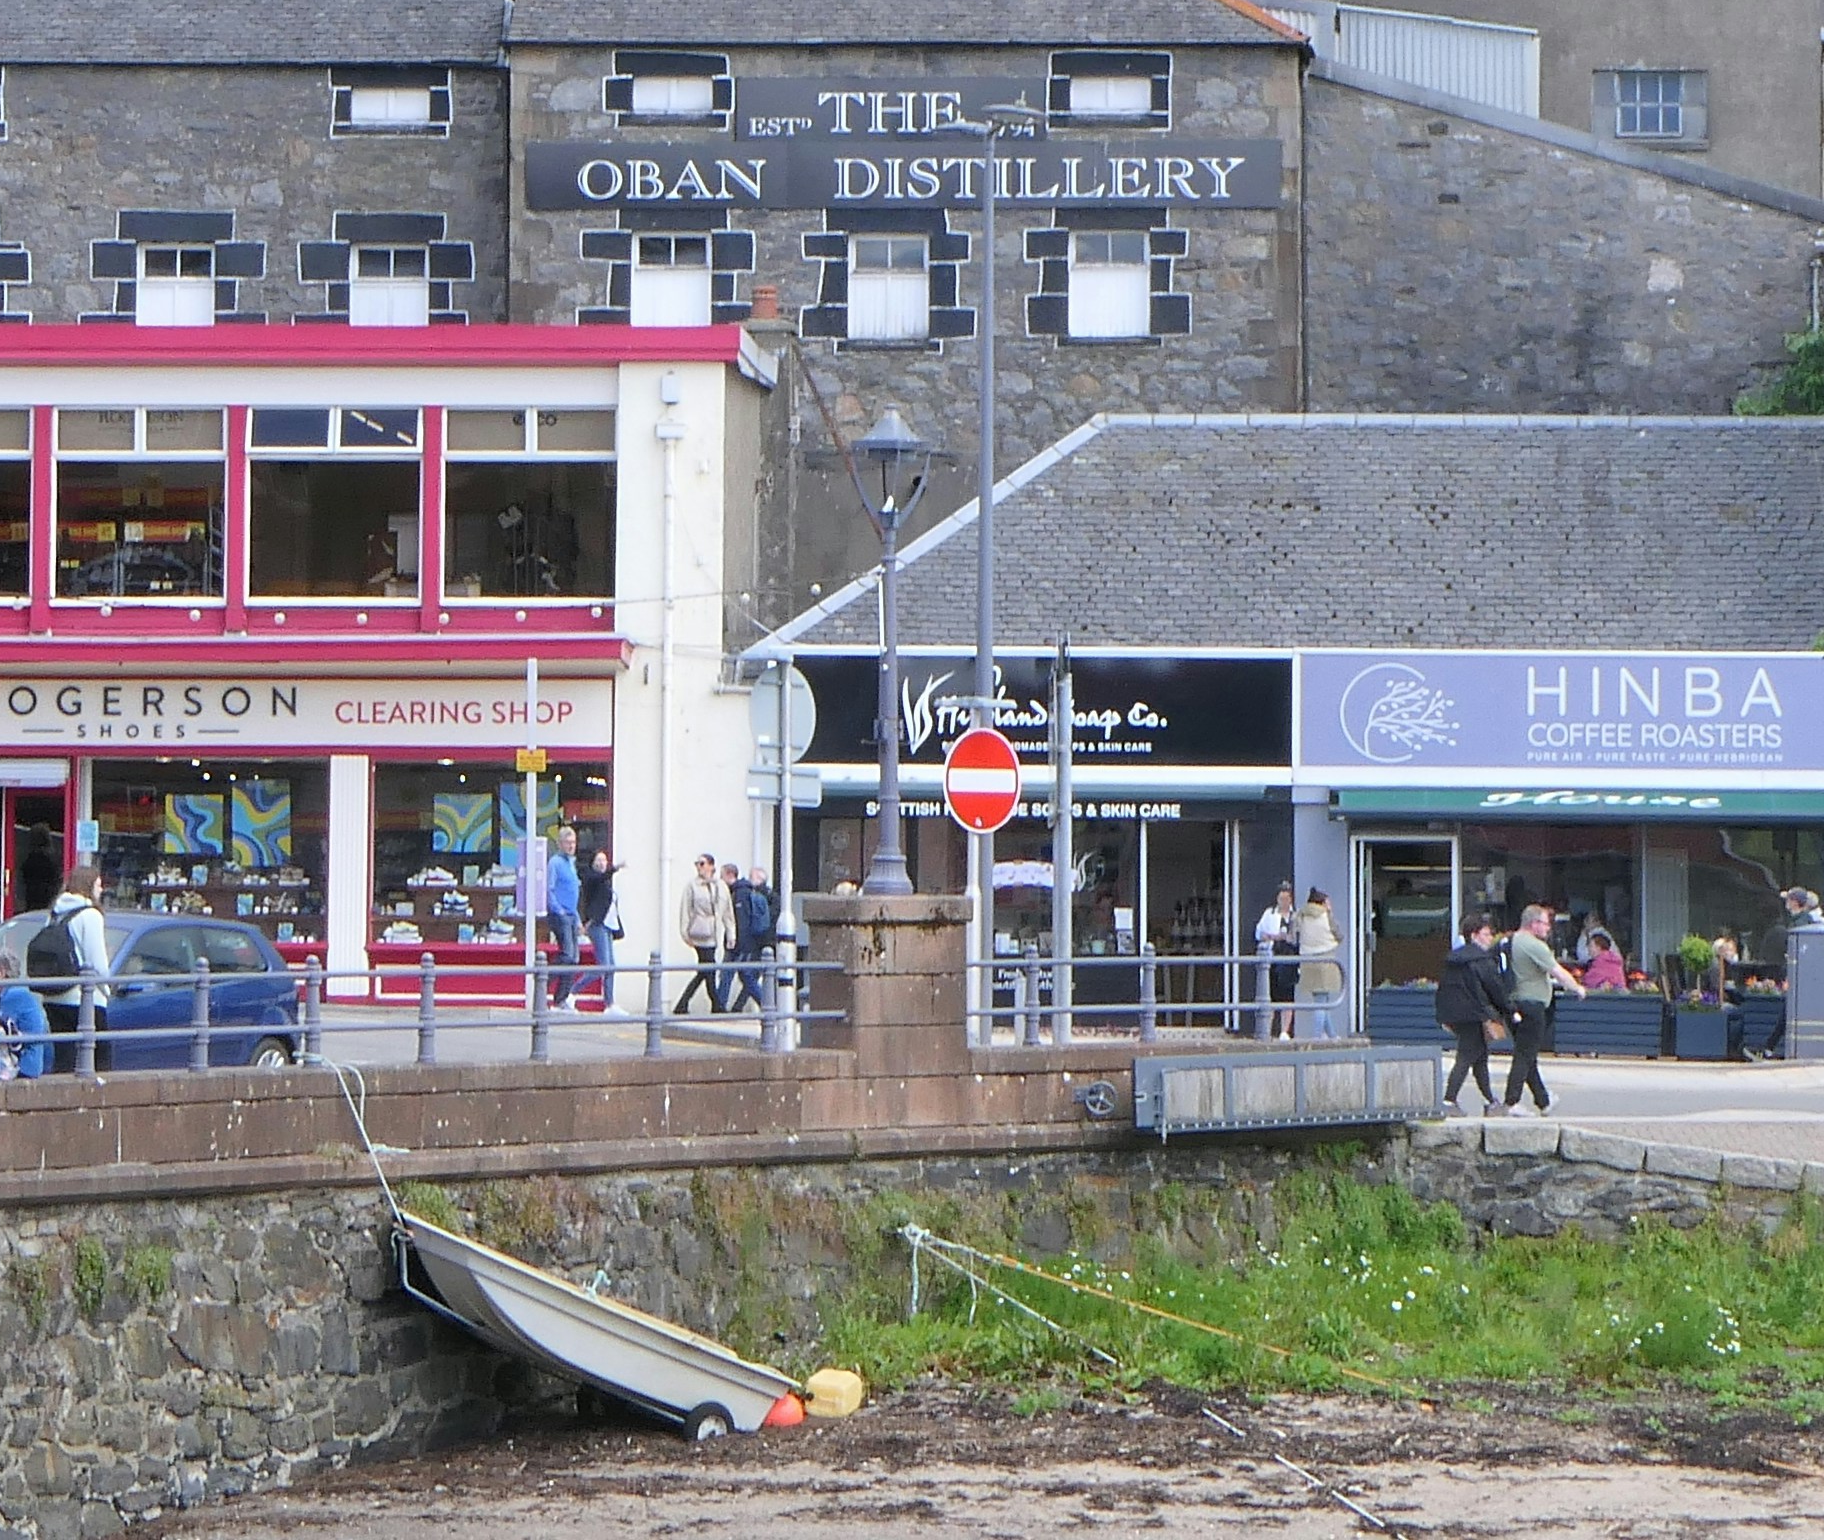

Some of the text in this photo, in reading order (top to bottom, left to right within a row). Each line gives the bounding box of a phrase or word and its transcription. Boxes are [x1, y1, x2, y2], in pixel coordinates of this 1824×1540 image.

[818, 92, 961, 134] THE
[988, 120, 1045, 139] 794
[577, 157, 1246, 201] OBAN DISTILLERY
[1526, 666, 1782, 717] HINBA
[334, 700, 574, 725] CLEARING SHOP
[77, 724, 186, 739] SHOES
[1527, 722, 1783, 749] COFFEE ROASTERS
[1097, 741, 1122, 753] SKIN
[1124, 741, 1153, 754] CARE
[1527, 751, 1558, 762] PURE
[1595, 751, 1626, 762] PURE
[1631, 751, 1666, 763] TASTE
[1679, 752, 1710, 763] PURE
[865, 801, 941, 817] STTISH
[1100, 803, 1137, 818] SKIN
[1140, 803, 1182, 819] CARE
